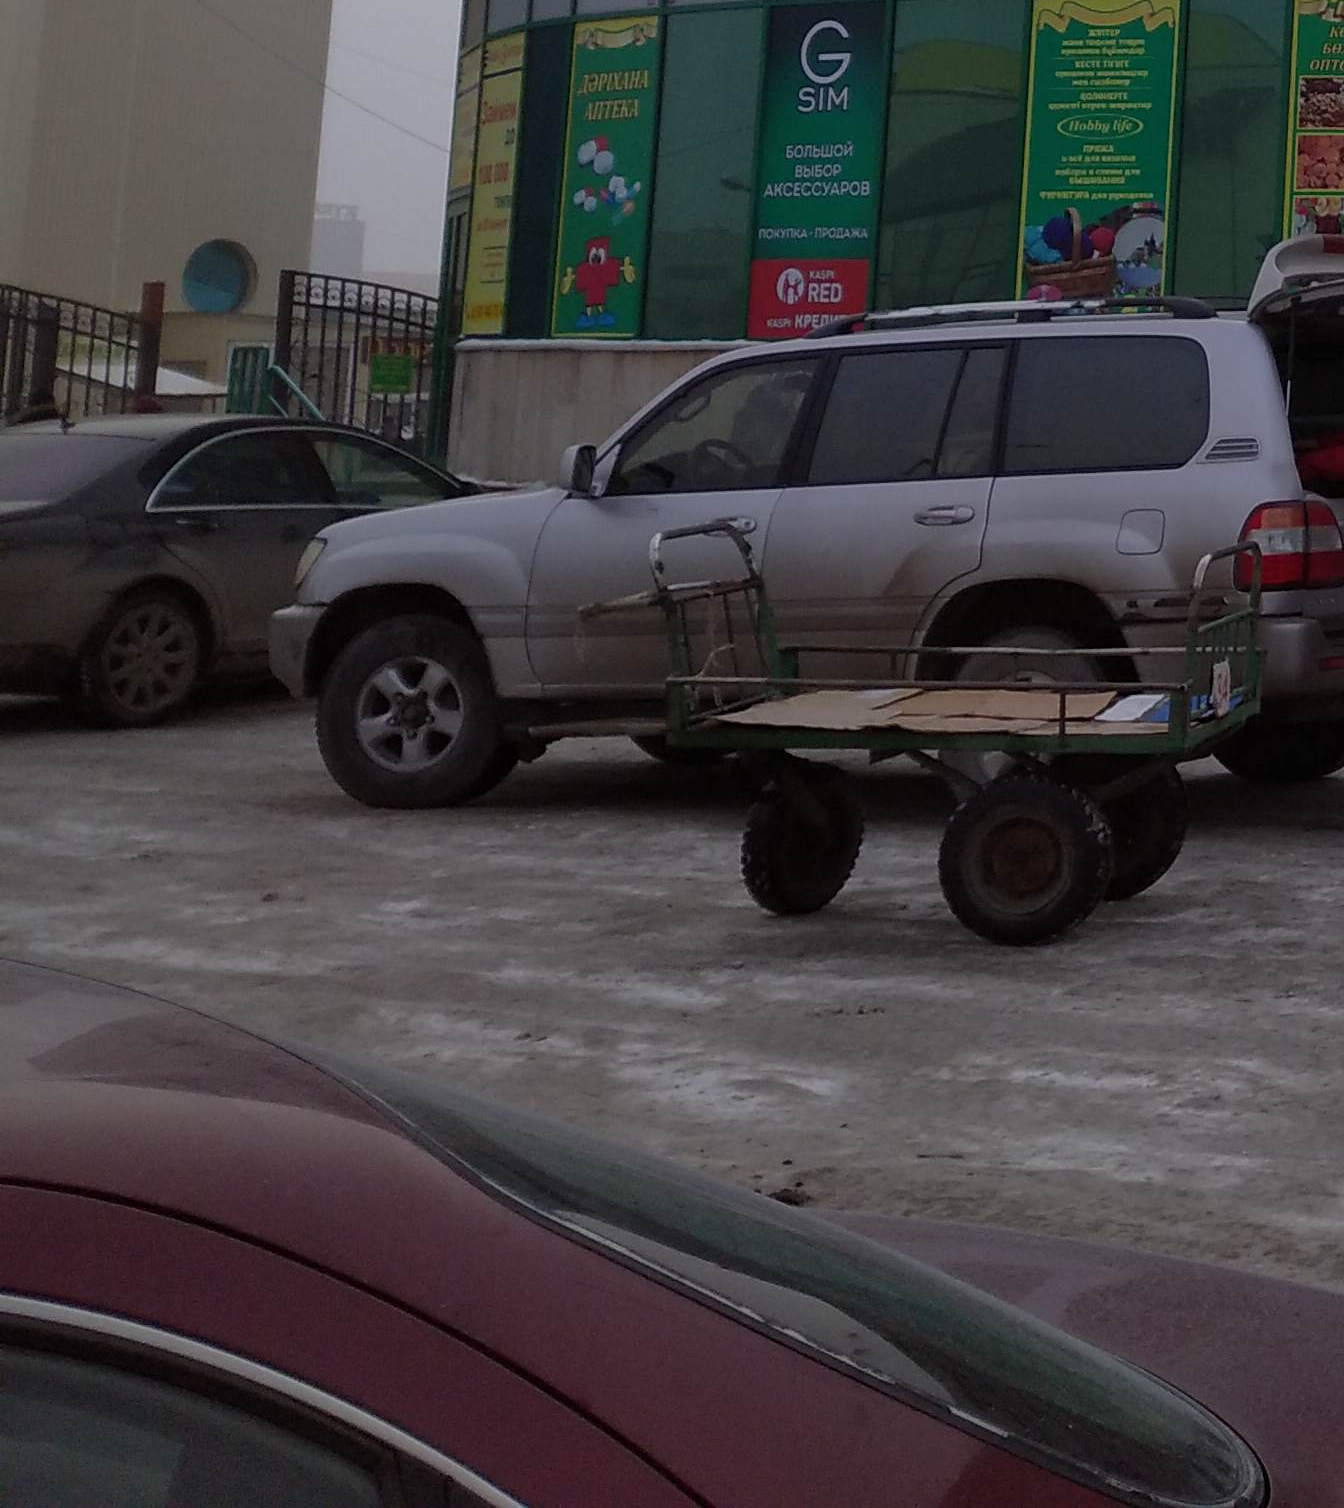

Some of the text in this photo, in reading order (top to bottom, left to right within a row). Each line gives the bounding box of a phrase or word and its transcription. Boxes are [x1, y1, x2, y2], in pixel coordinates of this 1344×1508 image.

[800, 19, 853, 86] G
[796, 86, 850, 113] SIM
[1068, 119, 1110, 134] Hobby
[784, 140, 856, 159] БОЛЬШОЙ
[794, 163, 842, 179] ВЫБОР
[762, 181, 871, 198] АКСЕССУАРОВ
[807, 282, 843, 304] RED
